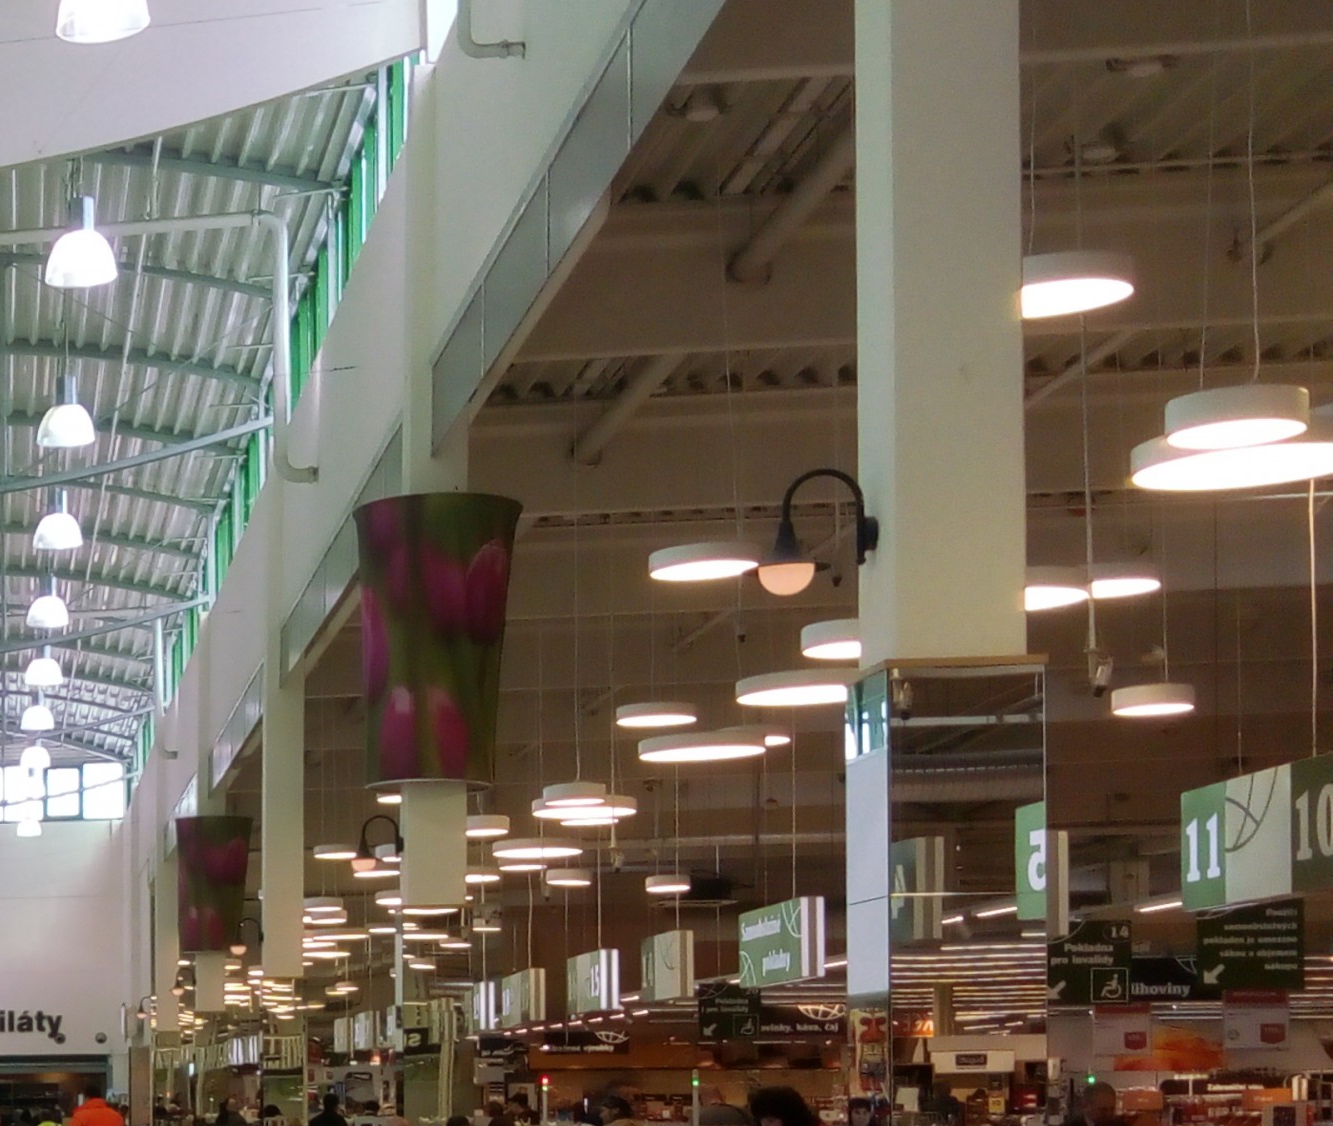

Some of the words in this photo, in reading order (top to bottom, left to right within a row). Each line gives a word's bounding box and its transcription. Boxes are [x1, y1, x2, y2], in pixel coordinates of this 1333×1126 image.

[1185, 812, 1221, 883] 11
[1110, 926, 1130, 938] 14
[1064, 942, 1114, 953] Pokladna
[1050, 957, 1069, 966] pro
[1072, 955, 1114, 966] invalidy
